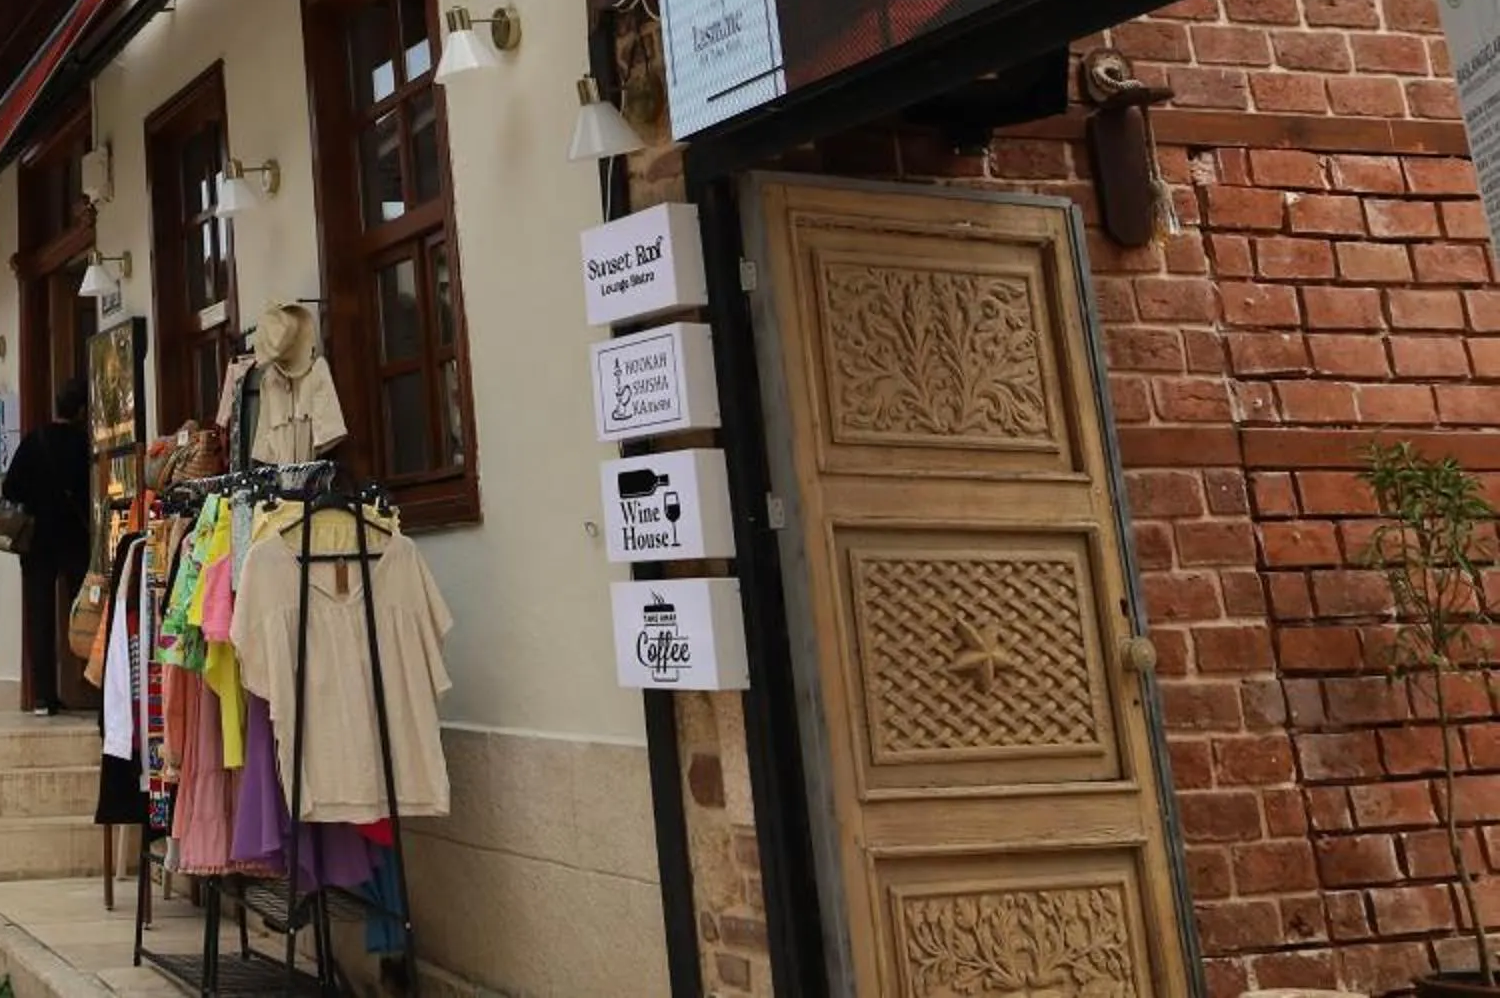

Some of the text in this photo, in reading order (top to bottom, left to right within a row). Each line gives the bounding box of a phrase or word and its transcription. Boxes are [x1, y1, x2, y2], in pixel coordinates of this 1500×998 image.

[587, 235, 663, 281] Sunset Roof
[624, 352, 667, 375] HOOKAH
[632, 374, 669, 395] SHISHA
[620, 500, 661, 524] Wine
[622, 526, 669, 551] House
[636, 630, 691, 674] Coffee
